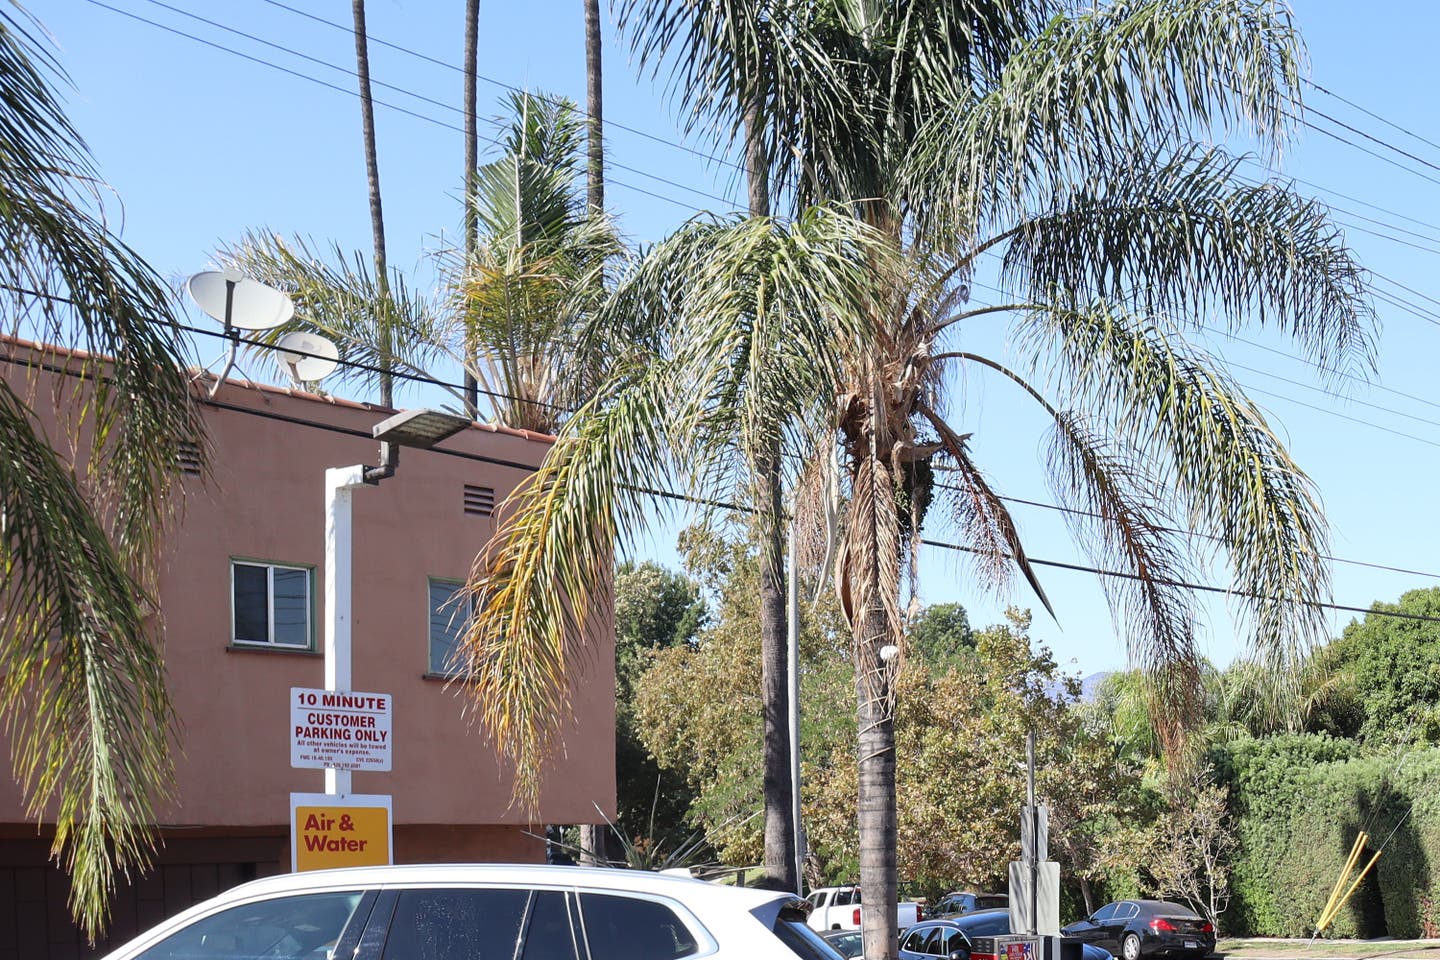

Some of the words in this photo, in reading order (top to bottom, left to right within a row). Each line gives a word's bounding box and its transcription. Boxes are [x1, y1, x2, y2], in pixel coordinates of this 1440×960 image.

[298, 693, 317, 706] 10
[322, 694, 386, 710] MINUTE
[307, 713, 376, 728] CUSTOMER
[295, 726, 351, 740] PARKING
[355, 729, 387, 742] ONLY
[323, 741, 347, 749] vehicles
[304, 813, 335, 831] Air
[339, 814, 354, 831] &
[304, 835, 368, 852] Water
